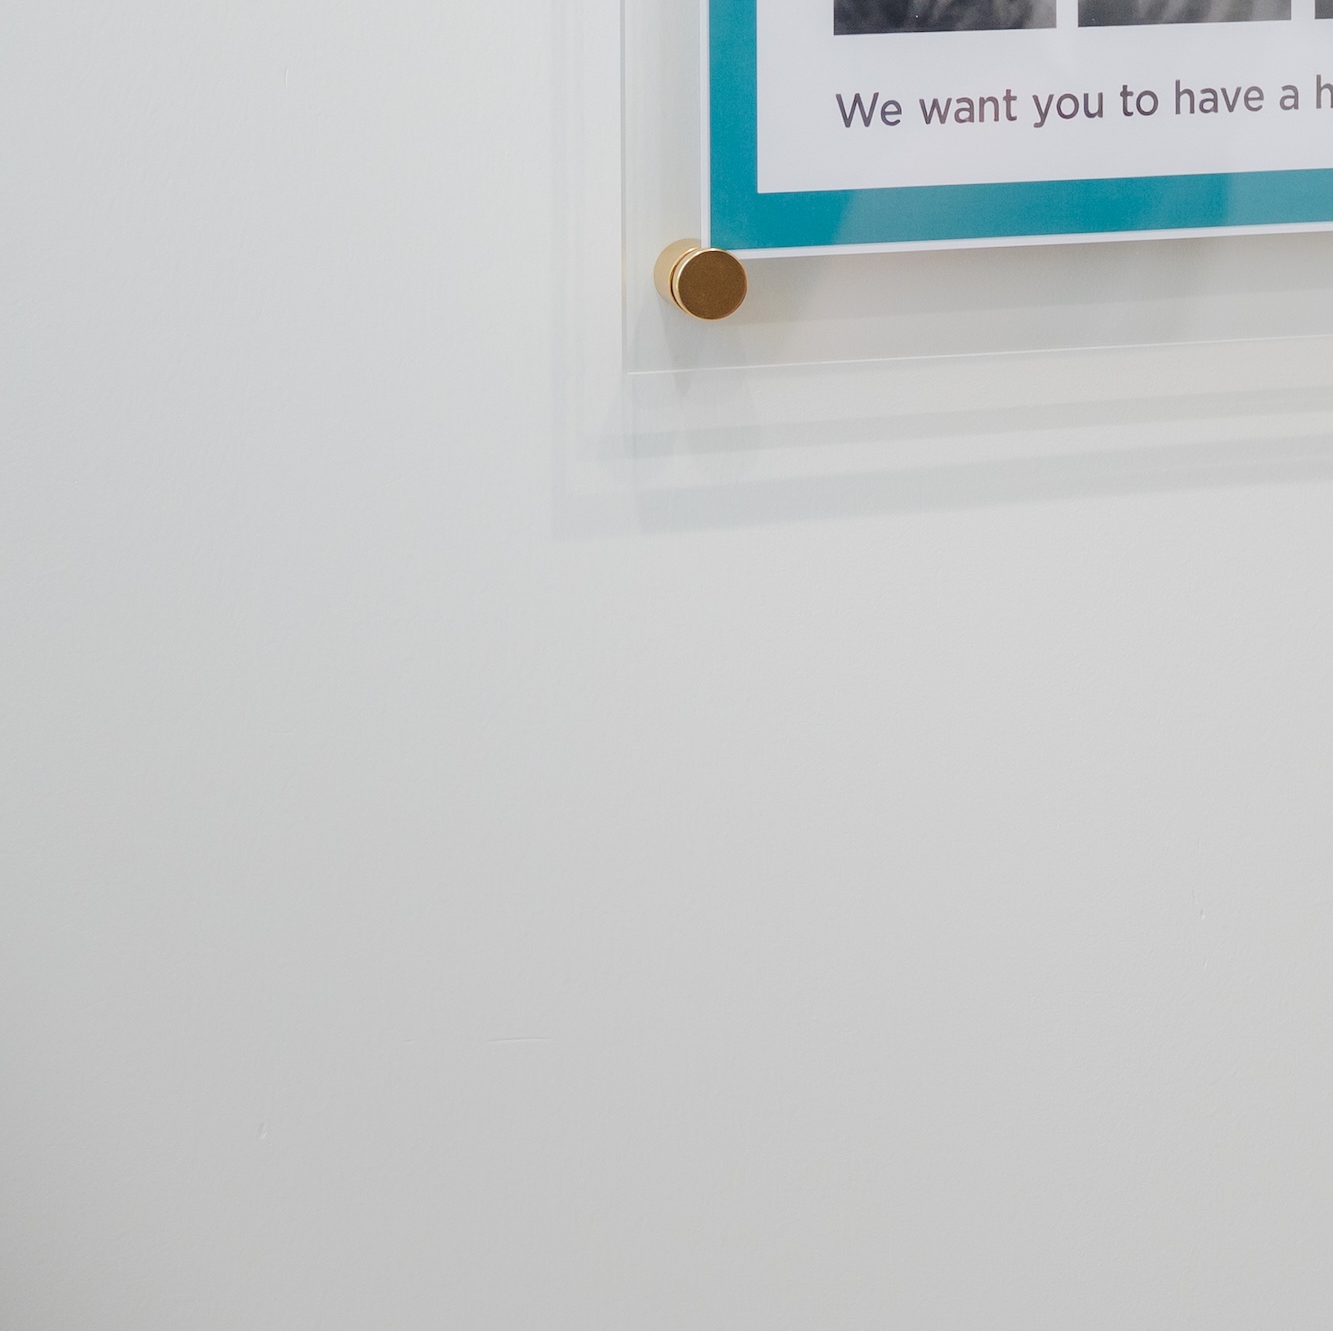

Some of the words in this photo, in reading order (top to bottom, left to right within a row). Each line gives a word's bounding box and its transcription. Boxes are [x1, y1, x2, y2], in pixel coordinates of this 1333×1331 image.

[836, 92, 902, 128] We
[919, 89, 1017, 124] want
[1032, 92, 1103, 128] you
[1120, 85, 1158, 116] to
[1175, 80, 1264, 115] have
[1280, 85, 1299, 110] a
